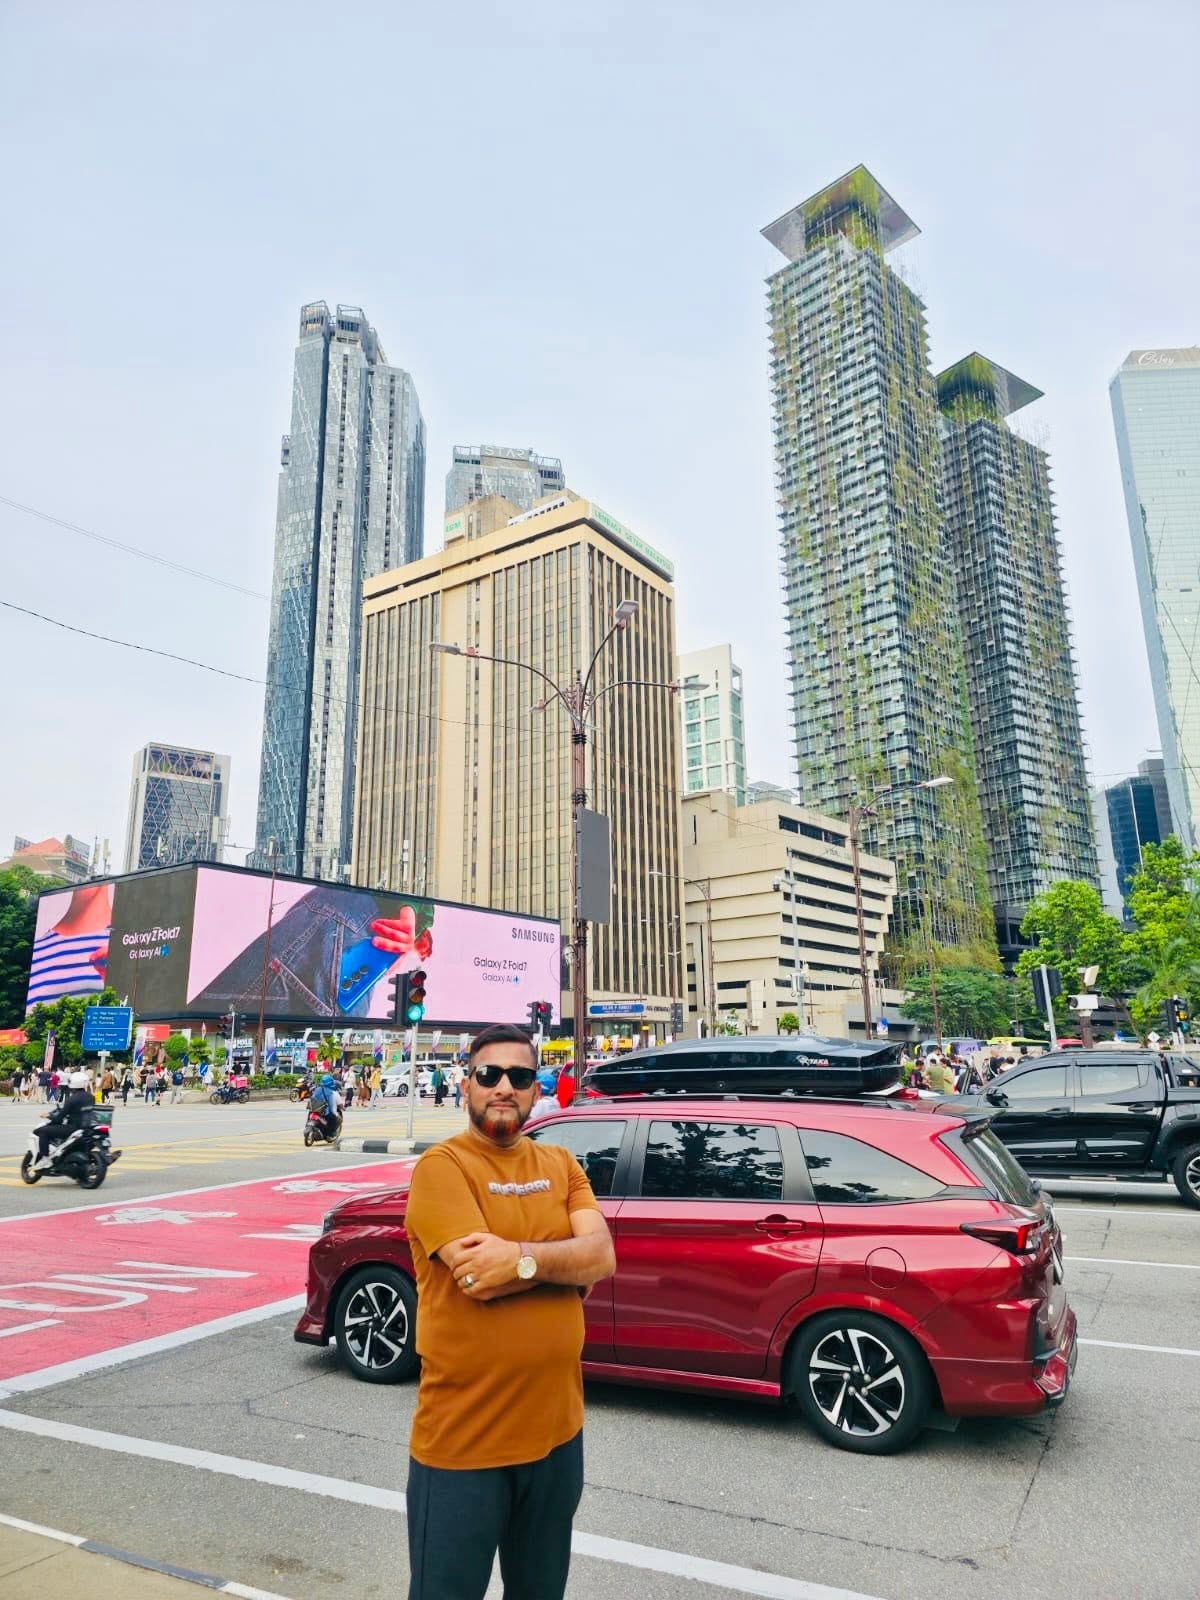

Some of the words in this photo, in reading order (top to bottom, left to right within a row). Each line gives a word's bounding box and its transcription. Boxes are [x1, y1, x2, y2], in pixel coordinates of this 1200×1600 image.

[484, 446, 525, 459] STAR
[122, 932, 152, 945] Galaxy
[158, 926, 181, 941] Fold7
[511, 927, 555, 944] SAMSUNG
[473, 956, 501, 971] Galaxy
[502, 959, 507, 969] Z
[508, 960, 527, 971] Fold7
[482, 972, 505, 984] Galaxy
